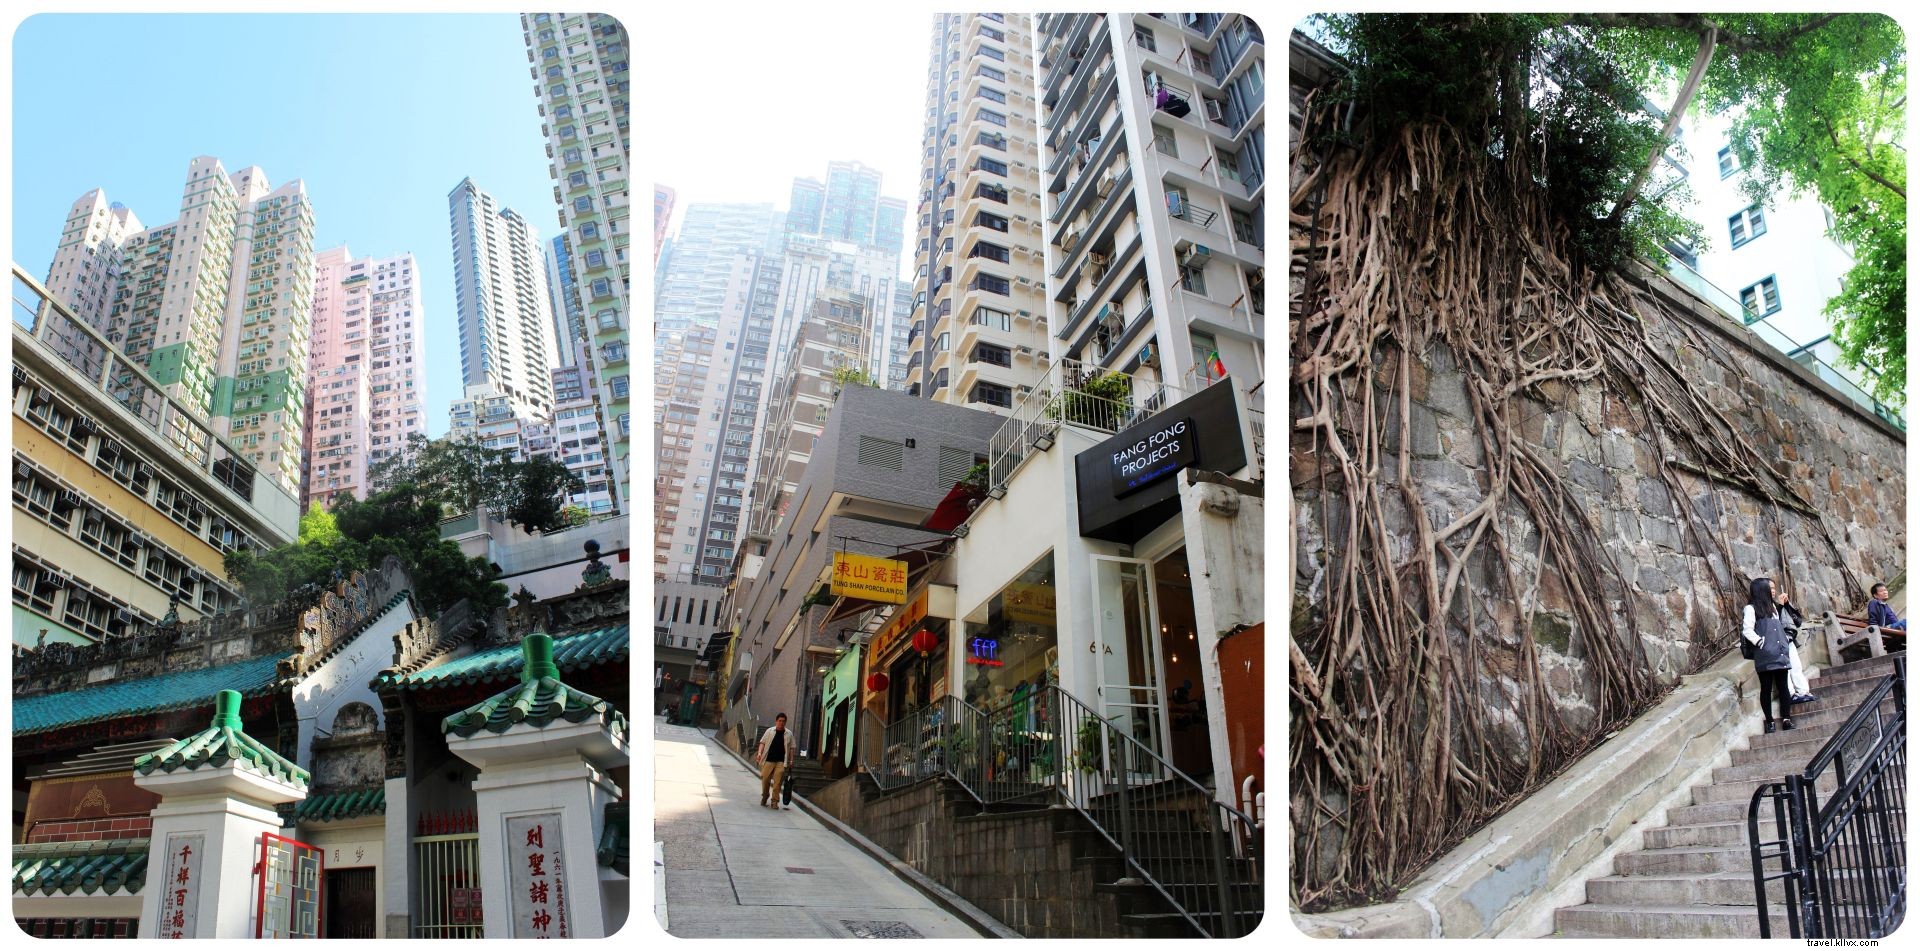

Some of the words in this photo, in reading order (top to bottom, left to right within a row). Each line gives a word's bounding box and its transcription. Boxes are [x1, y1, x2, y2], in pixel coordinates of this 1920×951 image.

[1113, 441, 1147, 465] FANG
[1149, 421, 1186, 448] FONG
[1122, 440, 1180, 477] PROJECTS
[834, 580, 848, 588] TUNG
[865, 584, 895, 595] PORCELAIN
[835, 561, 905, 584] 東山瓷莊
[1089, 641, 1113, 656] 6A
[526, 825, 551, 939] 列聖諸神
